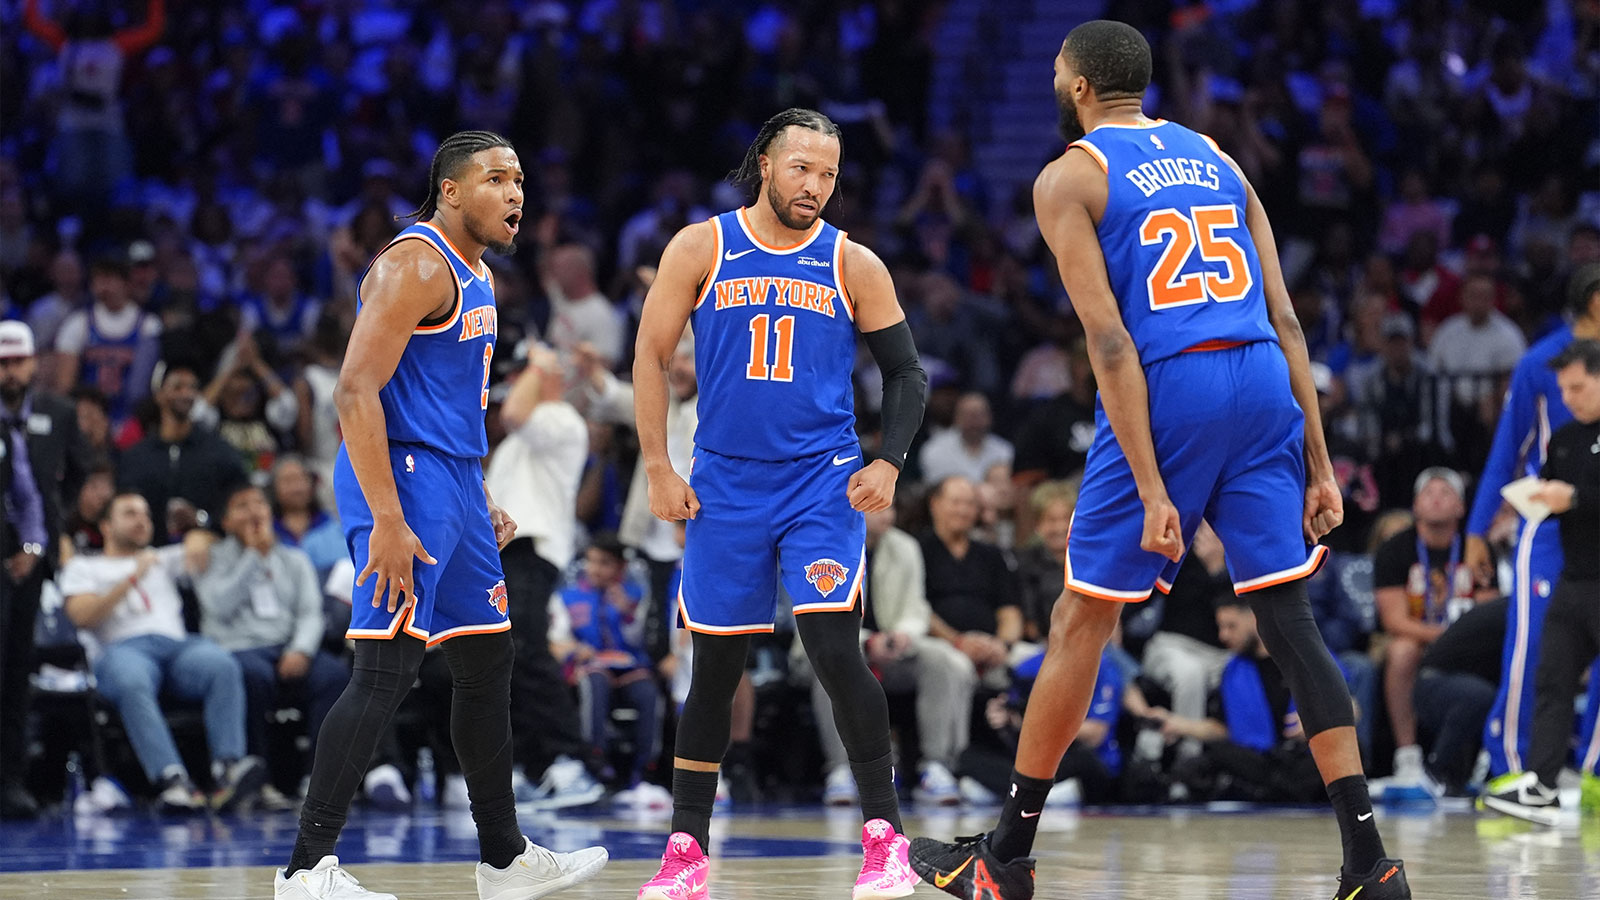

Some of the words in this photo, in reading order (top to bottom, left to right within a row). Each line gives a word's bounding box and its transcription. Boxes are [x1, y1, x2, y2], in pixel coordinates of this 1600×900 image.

[1125, 158, 1219, 197] BRIDGES
[1139, 204, 1253, 311] 25
[714, 277, 771, 311] NEW
[773, 277, 837, 318] YORK
[746, 314, 795, 382] 11
[481, 342, 493, 410] 2
[807, 562, 845, 580] KNICKS
